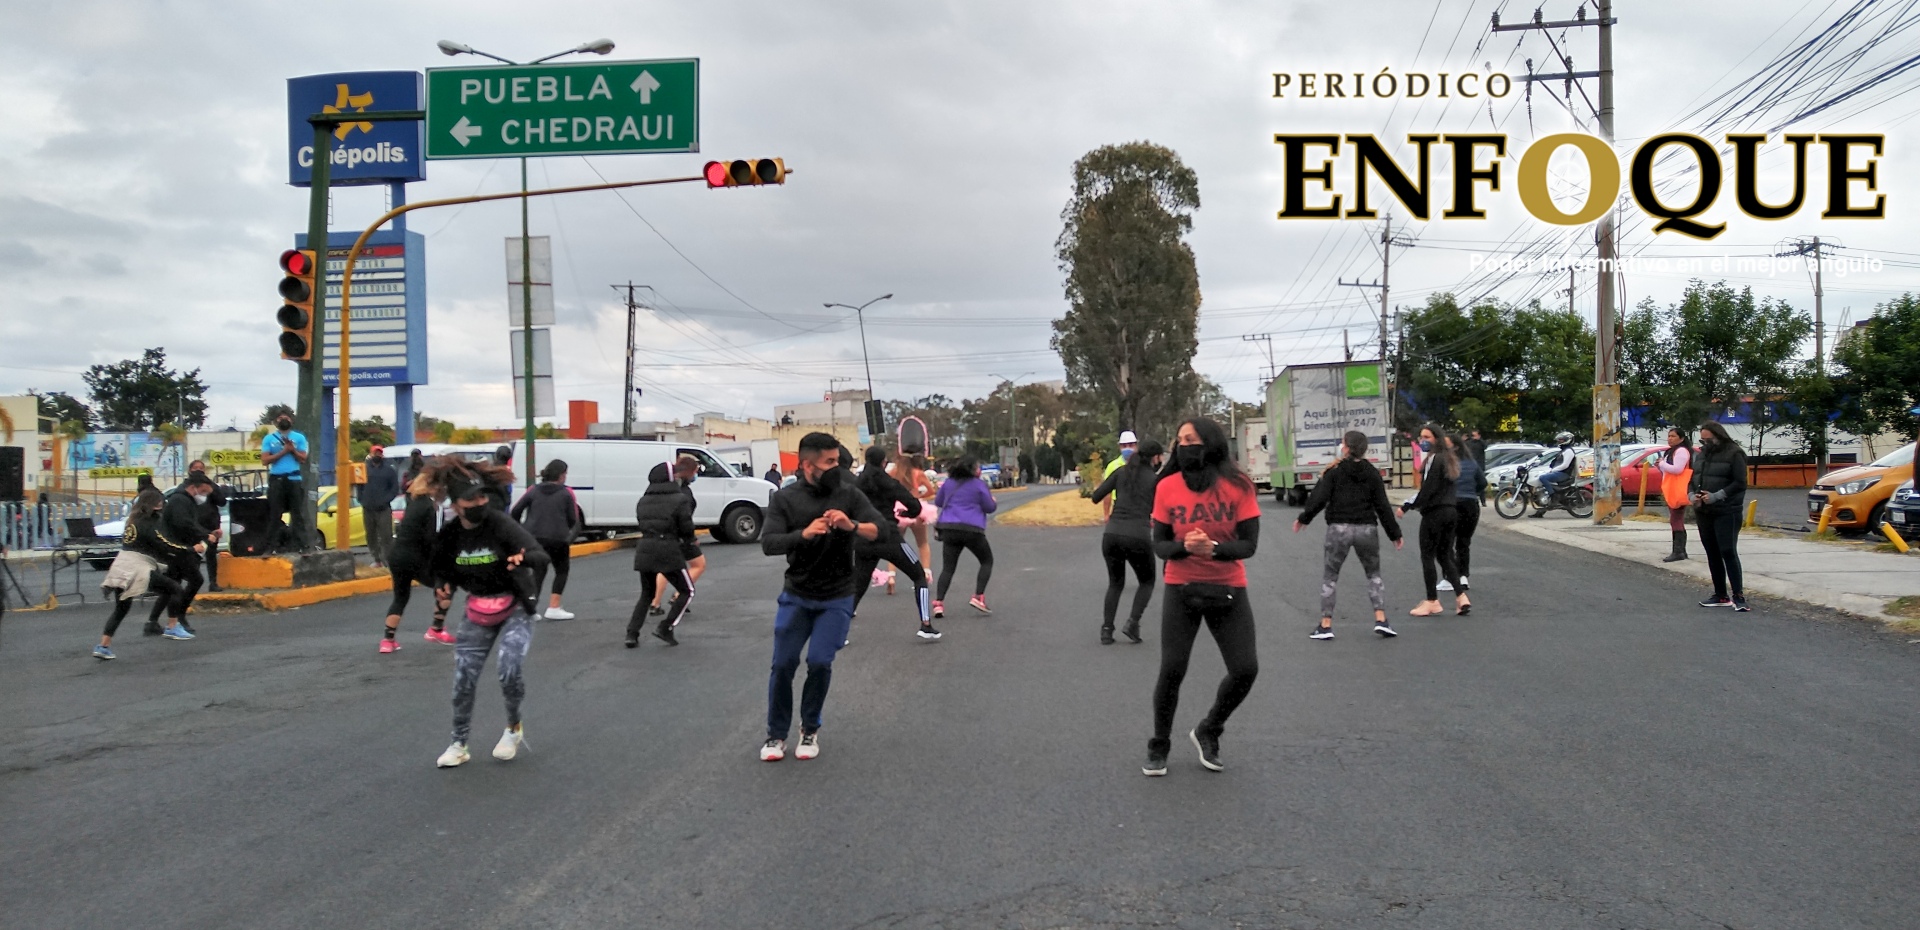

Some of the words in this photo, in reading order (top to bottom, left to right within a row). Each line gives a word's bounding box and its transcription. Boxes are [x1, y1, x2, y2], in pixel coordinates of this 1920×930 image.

[460, 74, 613, 104] PUEBLA
[501, 114, 674, 145] CHEDRAUI
[298, 142, 404, 168] Cépolis
[1304, 409, 1328, 420] Aquí
[1354, 418, 1377, 428] 24/7
[102, 468, 139, 476] SALIDA
[1168, 502, 1237, 524] RAW
